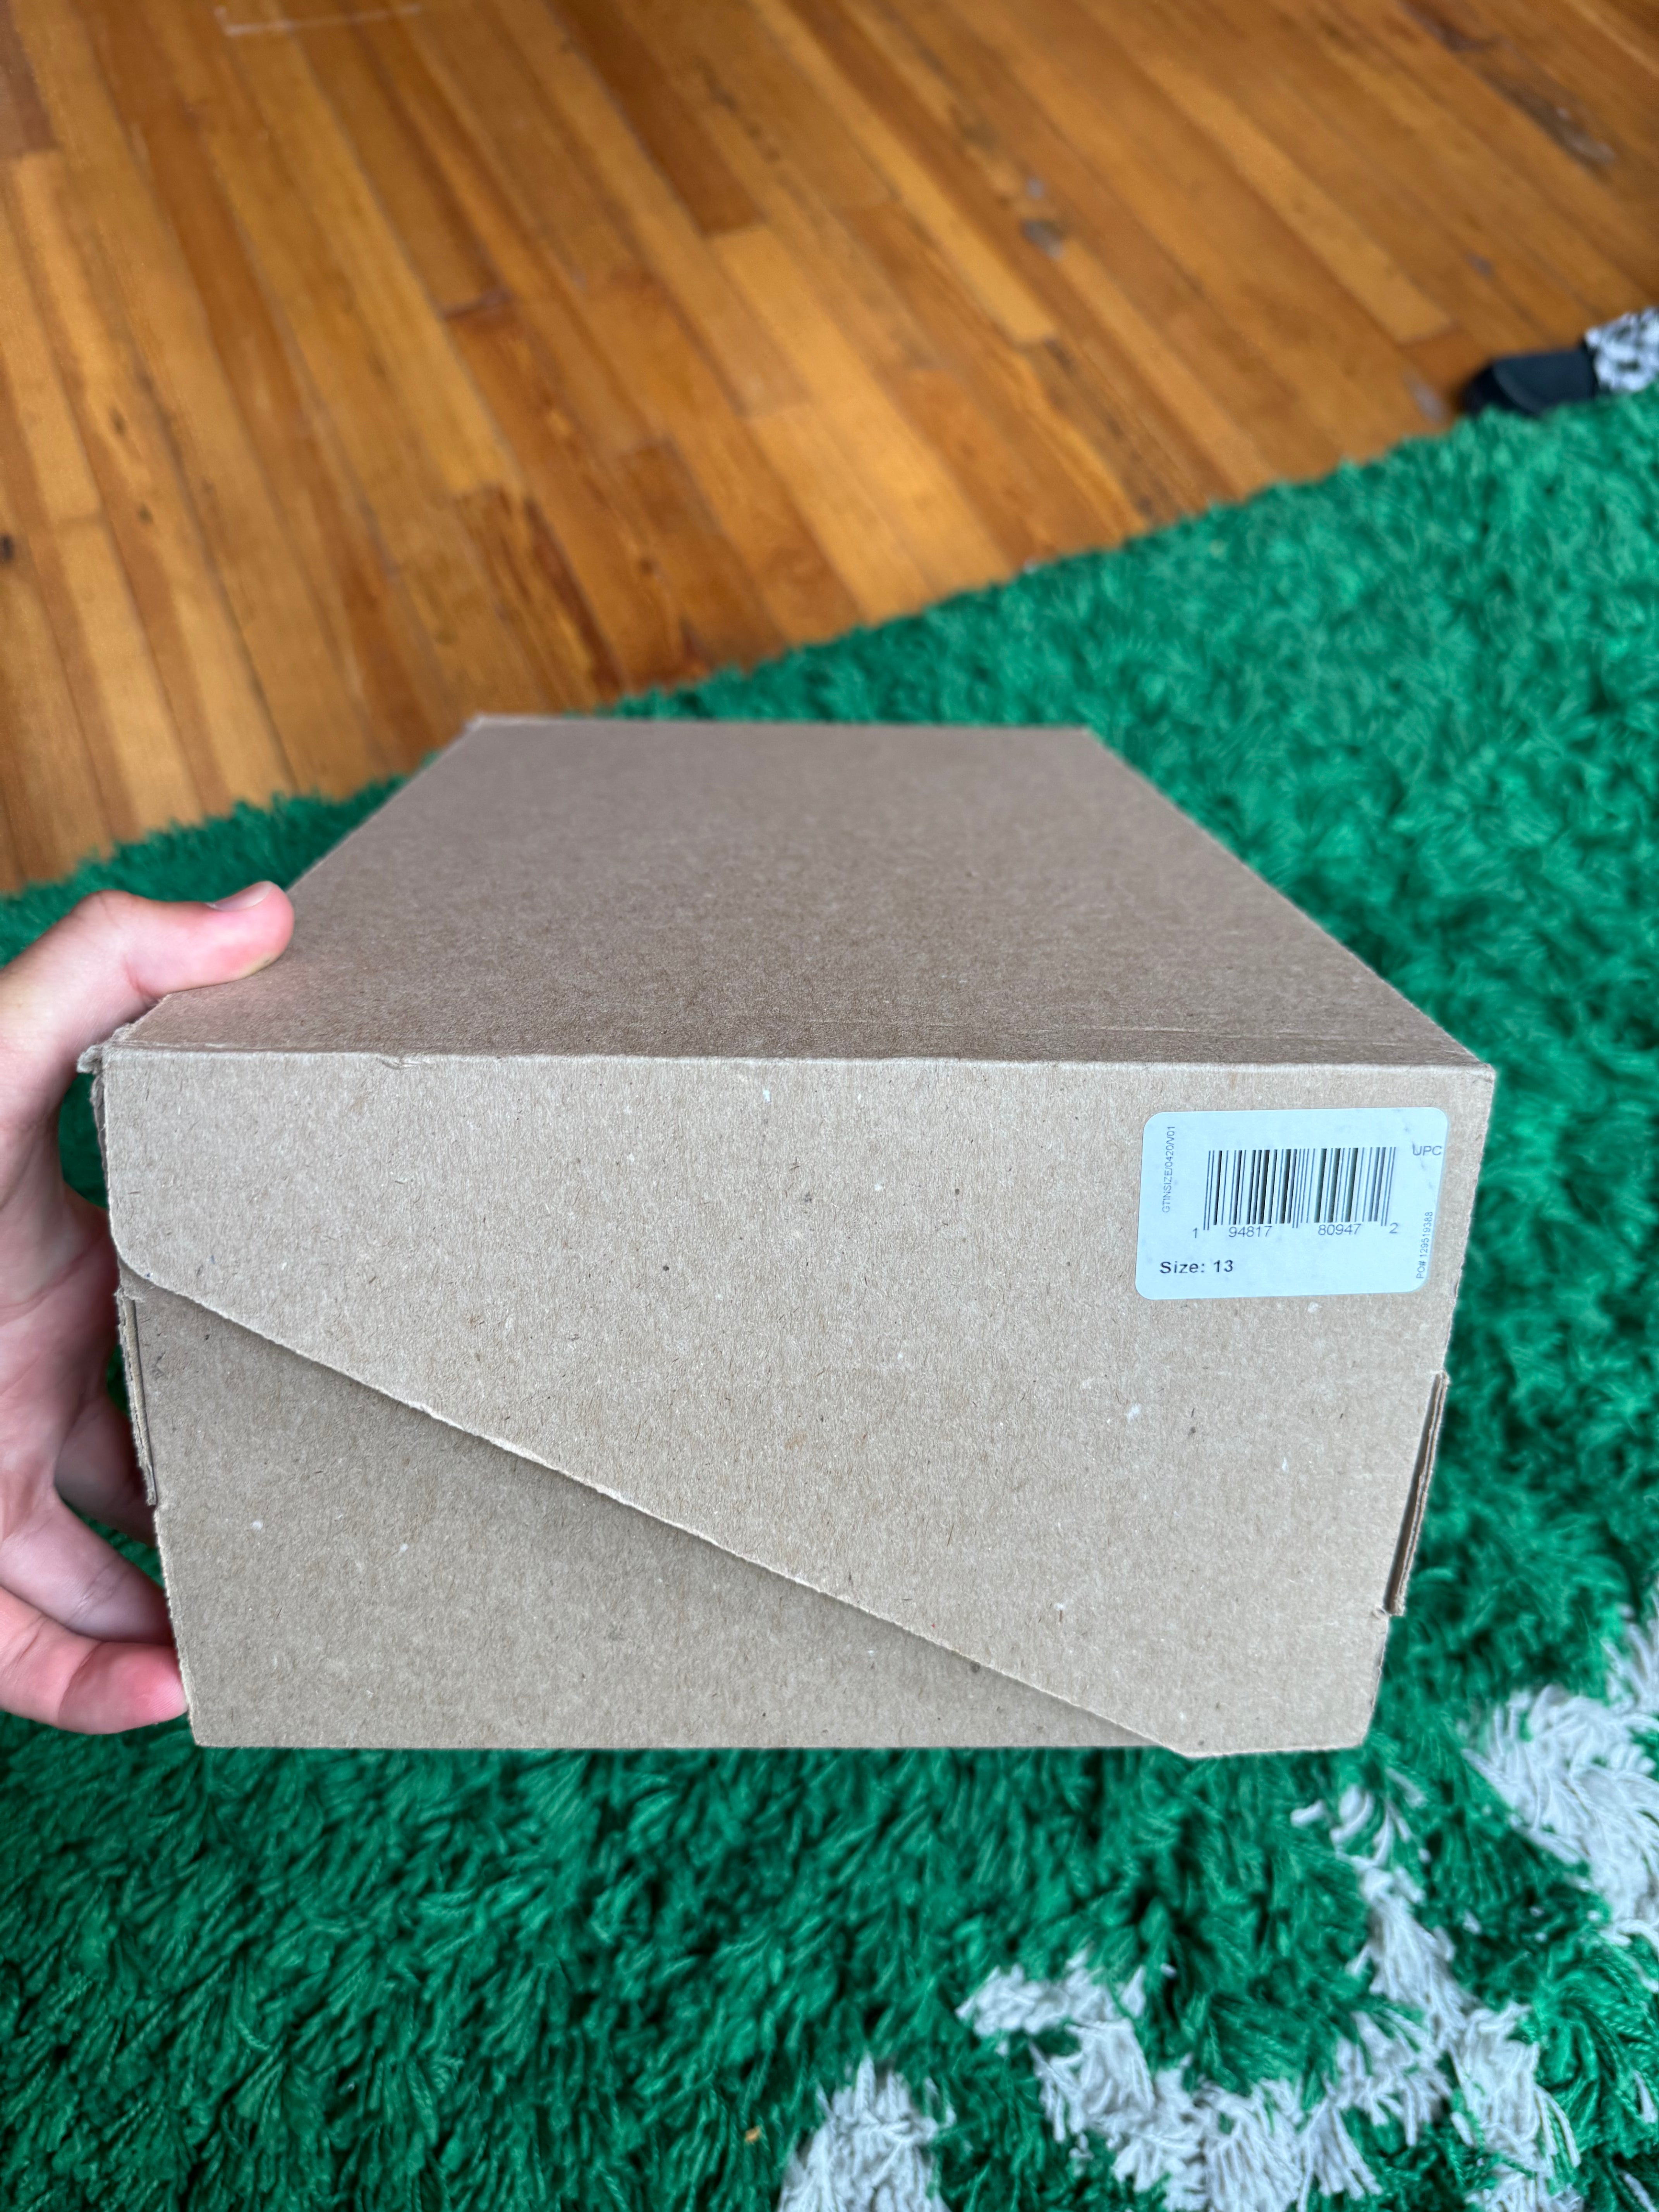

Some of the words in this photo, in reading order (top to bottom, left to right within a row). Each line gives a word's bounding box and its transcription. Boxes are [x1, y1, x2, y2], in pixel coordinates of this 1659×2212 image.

[1412, 1145, 1442, 1156] UPC
[1162, 1126, 1175, 1213] GTINSIZE/0420/V01
[1192, 1228, 1198, 1238] 1
[1228, 1226, 1272, 1237] 94817
[1317, 1224, 1362, 1235] 80947
[1389, 1223, 1398, 1234] 2
[1420, 1211, 1432, 1258] 129519388
[1160, 1262, 1205, 1274] Size:
[1213, 1261, 1233, 1273] 13
[1417, 1261, 1426, 1279] PO#
